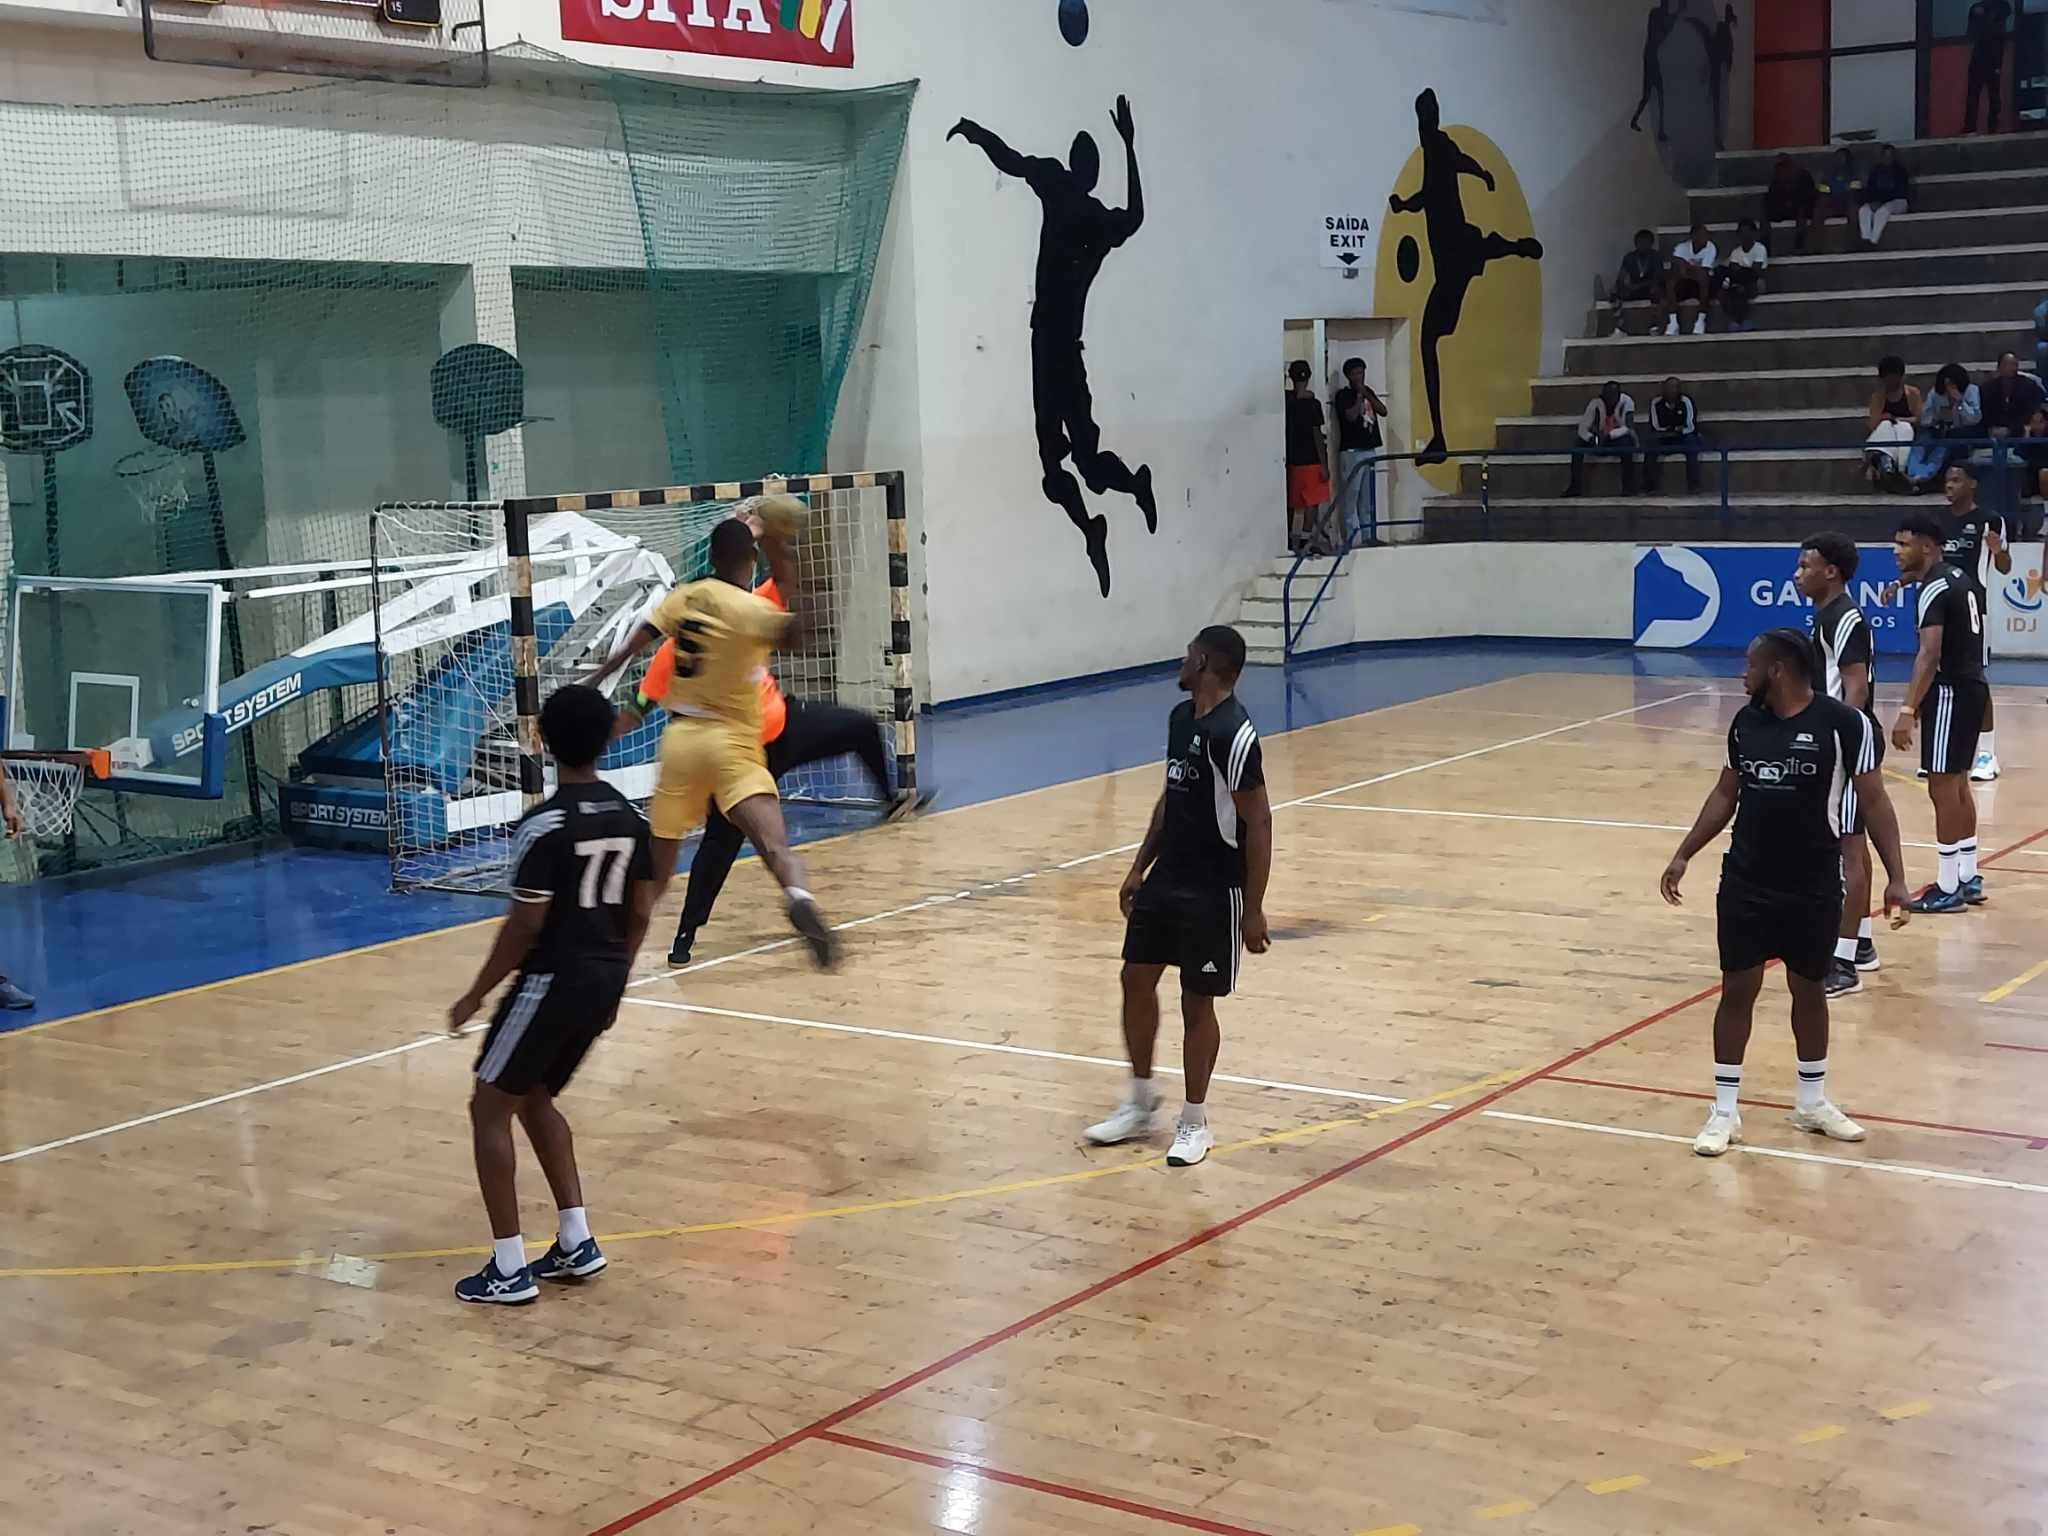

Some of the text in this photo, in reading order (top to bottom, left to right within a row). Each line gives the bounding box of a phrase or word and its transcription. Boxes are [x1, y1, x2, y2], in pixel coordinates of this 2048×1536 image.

[1330, 234, 1366, 248] EXIT
[2007, 618, 2037, 632] IDJ
[172, 672, 301, 752] SPOT SYSTEM
[575, 837, 636, 908] 77
